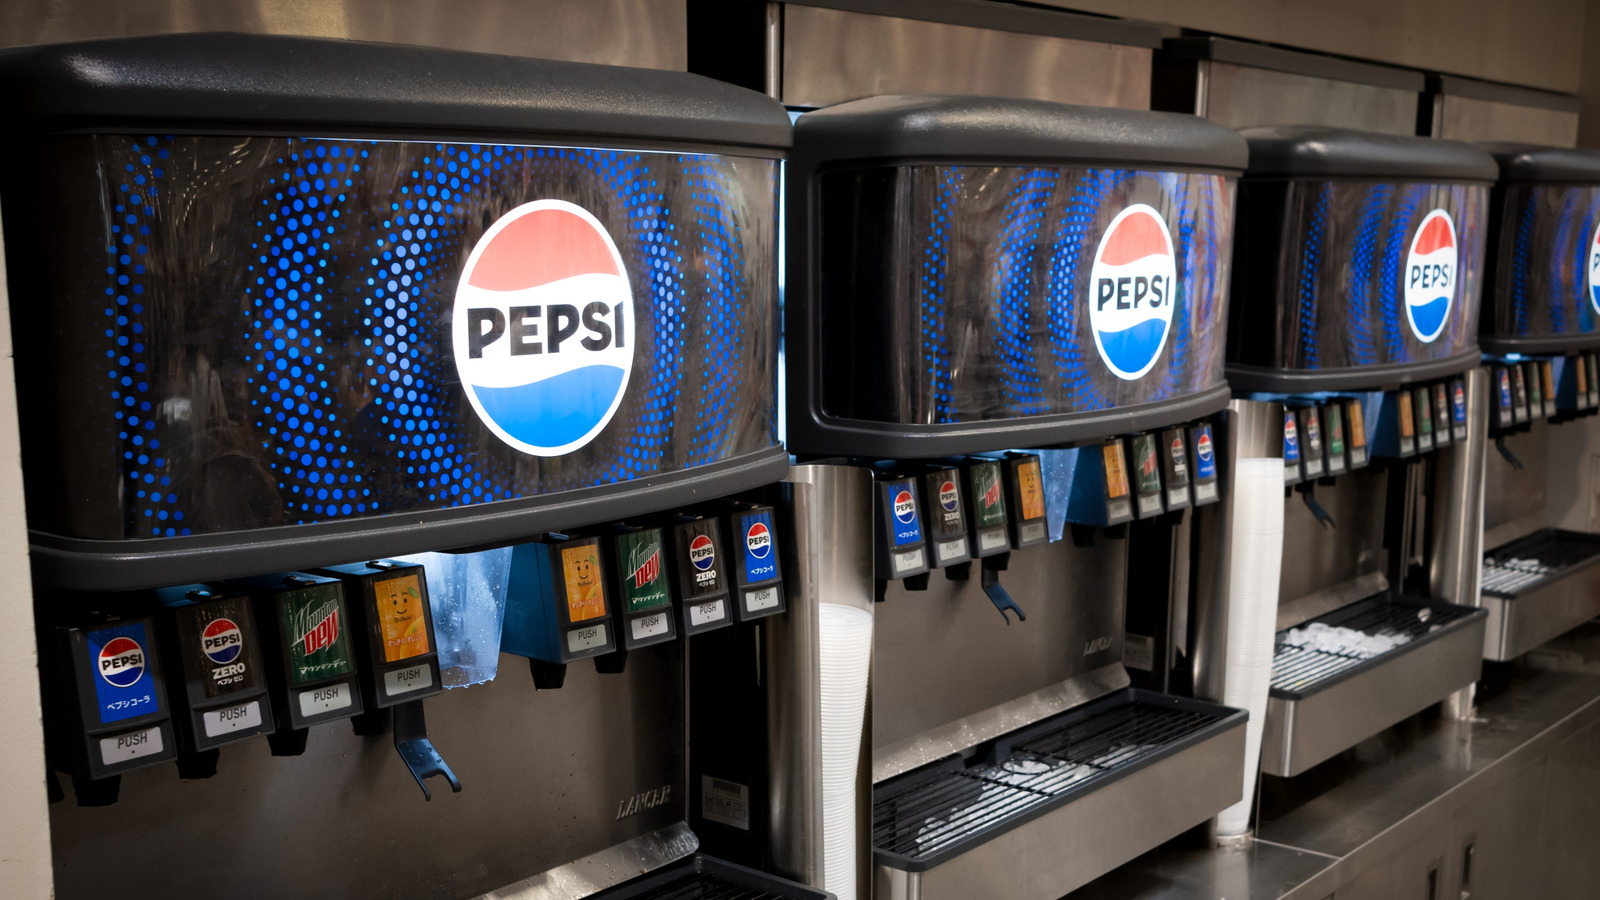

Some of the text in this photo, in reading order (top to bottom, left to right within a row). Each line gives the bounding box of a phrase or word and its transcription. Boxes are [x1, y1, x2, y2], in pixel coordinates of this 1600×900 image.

[1410, 263, 1454, 290] PEPSI
[1097, 274, 1170, 312] PEPSI
[467, 300, 626, 360] PEPSI
[896, 502, 914, 513] PEPSI
[748, 535, 770, 547] PEPSI
[691, 547, 713, 559] PEPSI
[902, 551, 916, 562] PUSH
[695, 569, 717, 582] ZERO
[750, 565, 774, 575] ペプシコーラ
[754, 591, 771, 602] PUSH
[699, 603, 717, 615] PUSH
[291, 599, 340, 647] Mountain
[641, 617, 660, 628] PUSH
[204, 632, 241, 650] PEPSI
[578, 628, 597, 641] PUSH
[102, 653, 143, 671] PEPSI
[211, 662, 246, 680] ZERO
[397, 669, 421, 683] PUSH
[106, 694, 151, 711] ペプシコーラ
[313, 687, 339, 703] PUSH
[219, 706, 247, 723] PUSH
[117, 732, 148, 750] PUSH
